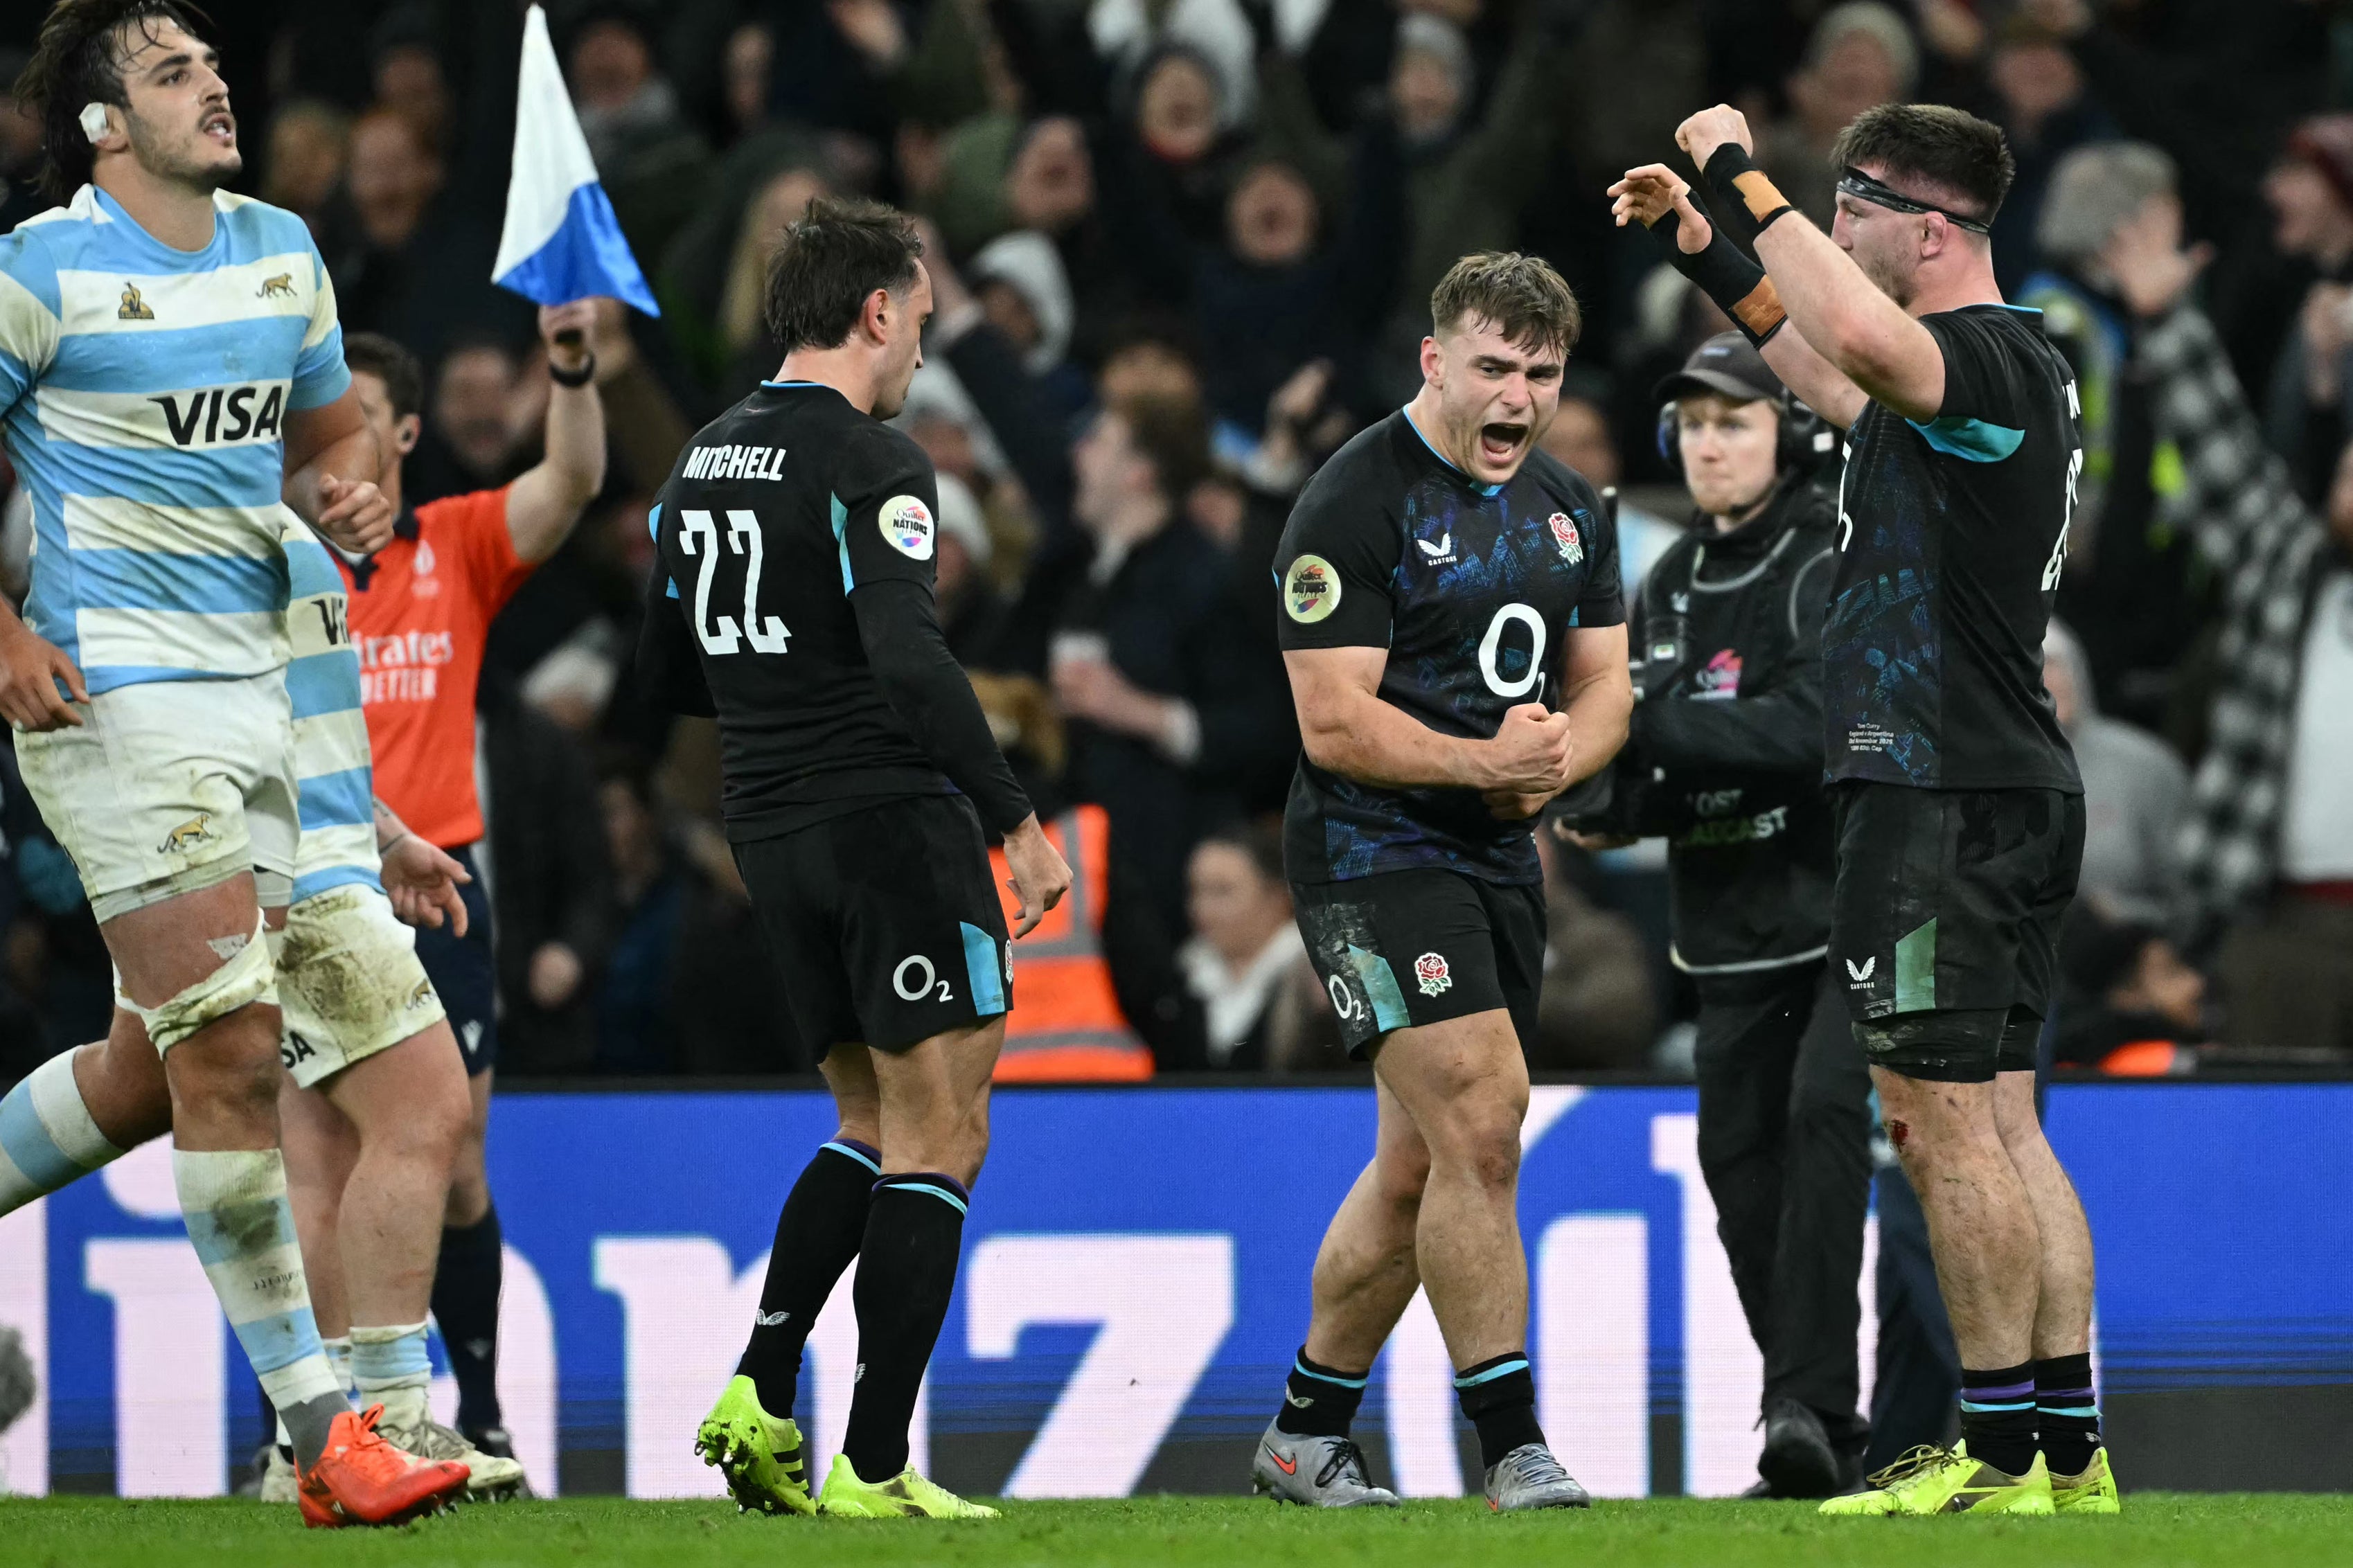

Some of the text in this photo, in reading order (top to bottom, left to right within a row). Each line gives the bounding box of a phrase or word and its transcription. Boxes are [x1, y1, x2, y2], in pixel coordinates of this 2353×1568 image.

[146, 385, 283, 445] VISA
[682, 444, 787, 481] MITCHELL
[893, 518, 927, 535] NATIONS
[896, 508, 924, 522] Quilter
[1428, 555, 1457, 566] CASTORE
[679, 510, 792, 655] 22
[350, 630, 454, 669] irates
[1685, 789, 1742, 817] OST
[893, 954, 953, 1002] O2
[1329, 974, 1365, 1021] O2
